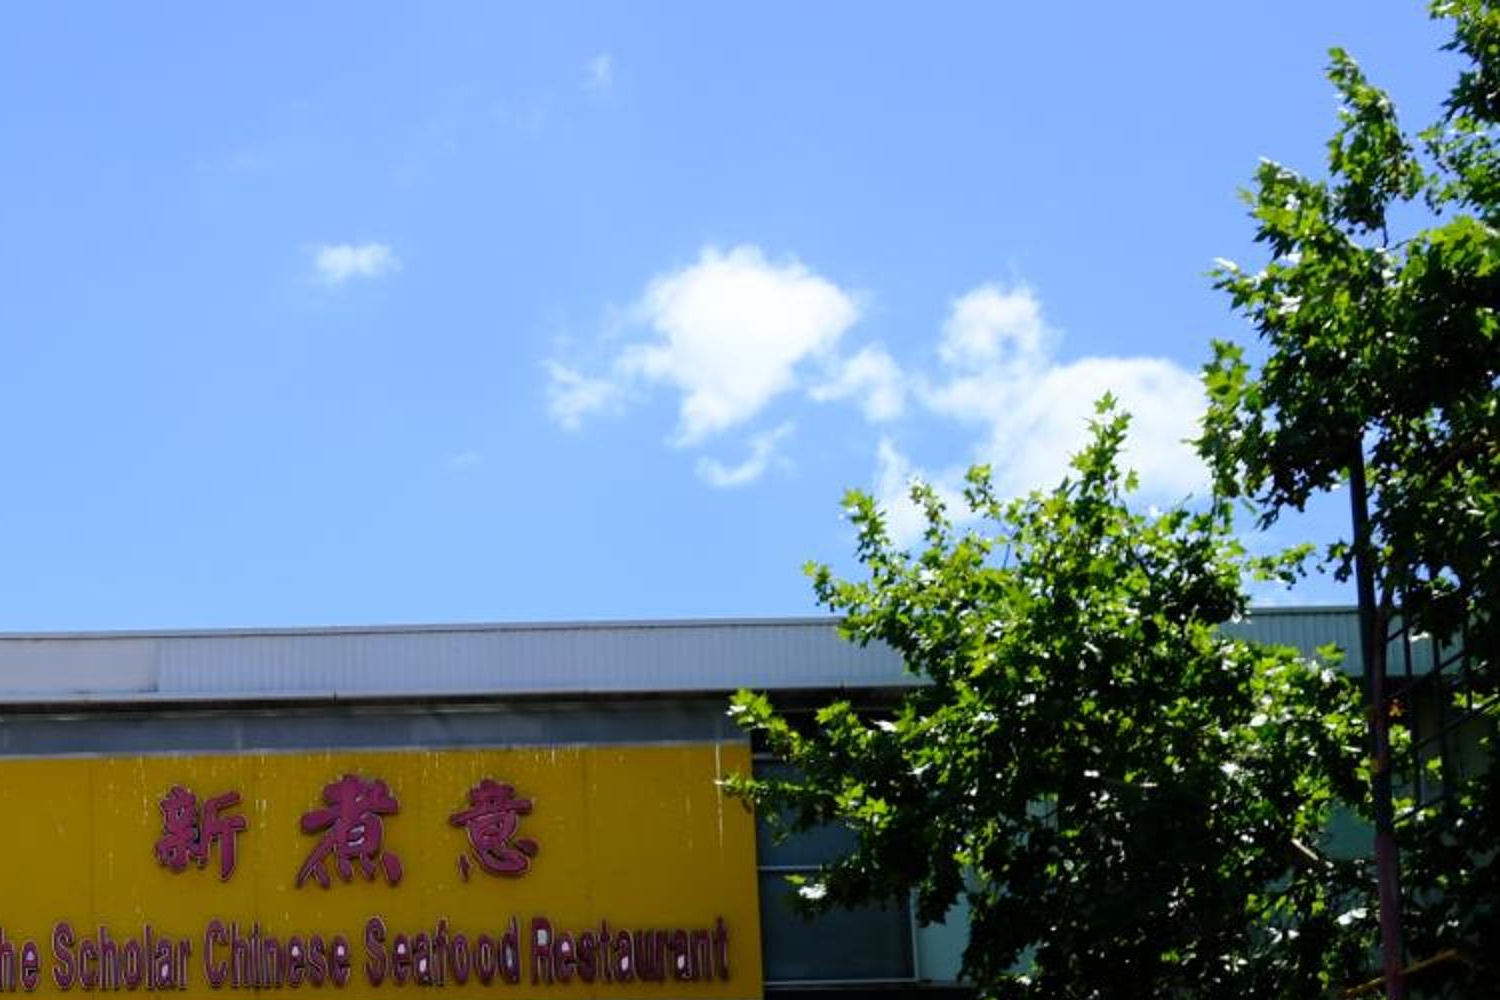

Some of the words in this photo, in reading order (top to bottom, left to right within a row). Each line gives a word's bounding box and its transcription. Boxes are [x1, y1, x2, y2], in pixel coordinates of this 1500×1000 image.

[155, 773, 539, 888] 新煮意
[51, 920, 192, 992] Scholar
[204, 919, 350, 990] Chinese
[364, 915, 521, 986] Seafood
[531, 915, 729, 985] Restaurant
